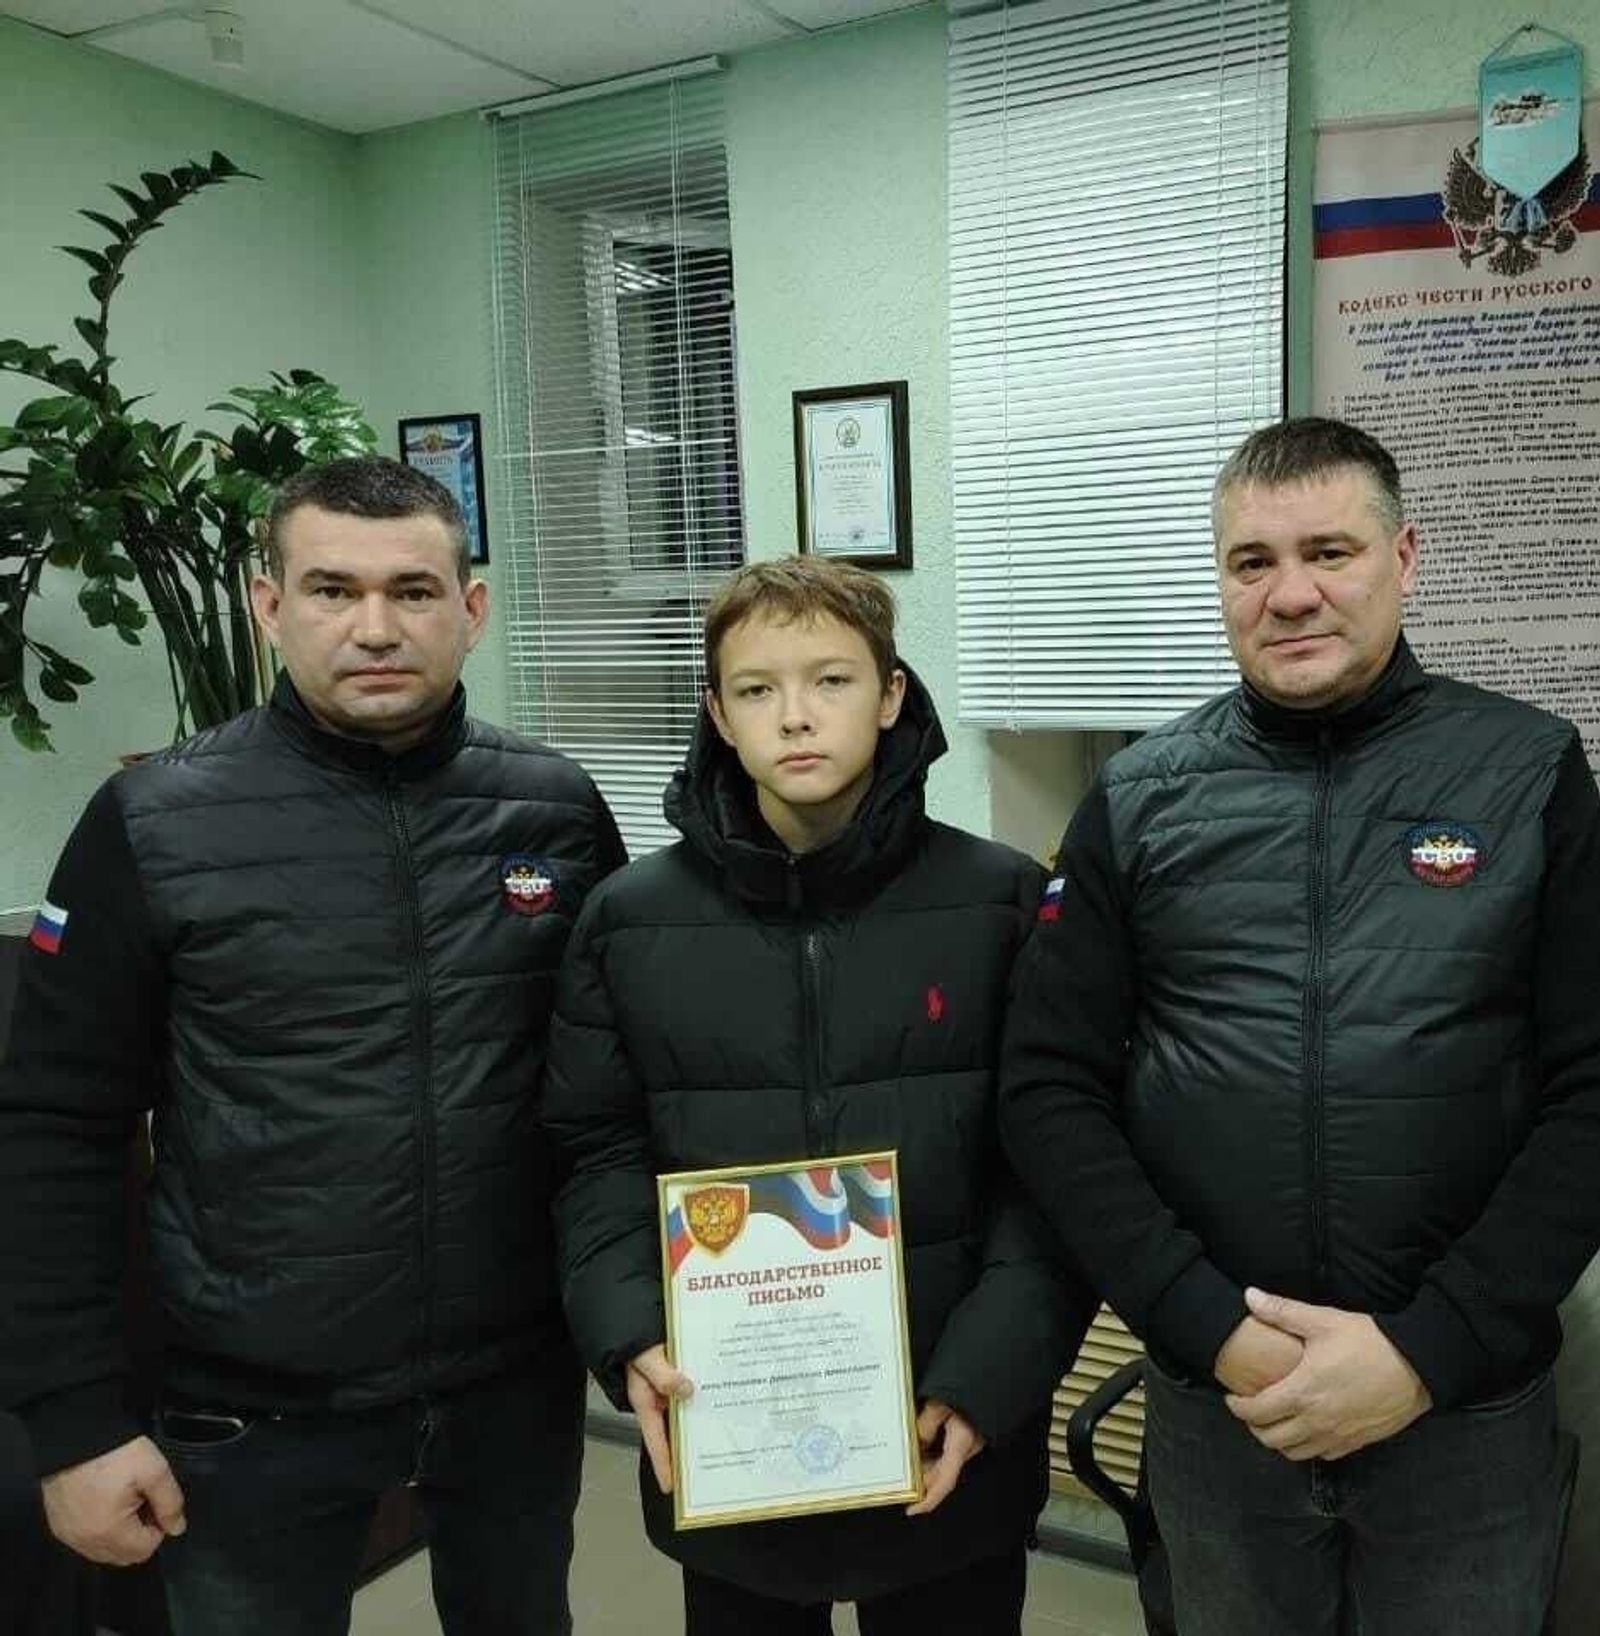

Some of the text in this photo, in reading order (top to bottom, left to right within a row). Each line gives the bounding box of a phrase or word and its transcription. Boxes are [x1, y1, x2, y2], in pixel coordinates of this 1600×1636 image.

[1338, 278, 1592, 315] КОДЕКС ЧЕСТИ РУССКОГО
[687, 1256, 883, 1293] БЛАГОДАРСТВЕННОЕ
[747, 1283, 825, 1307] ПИСЬМО
